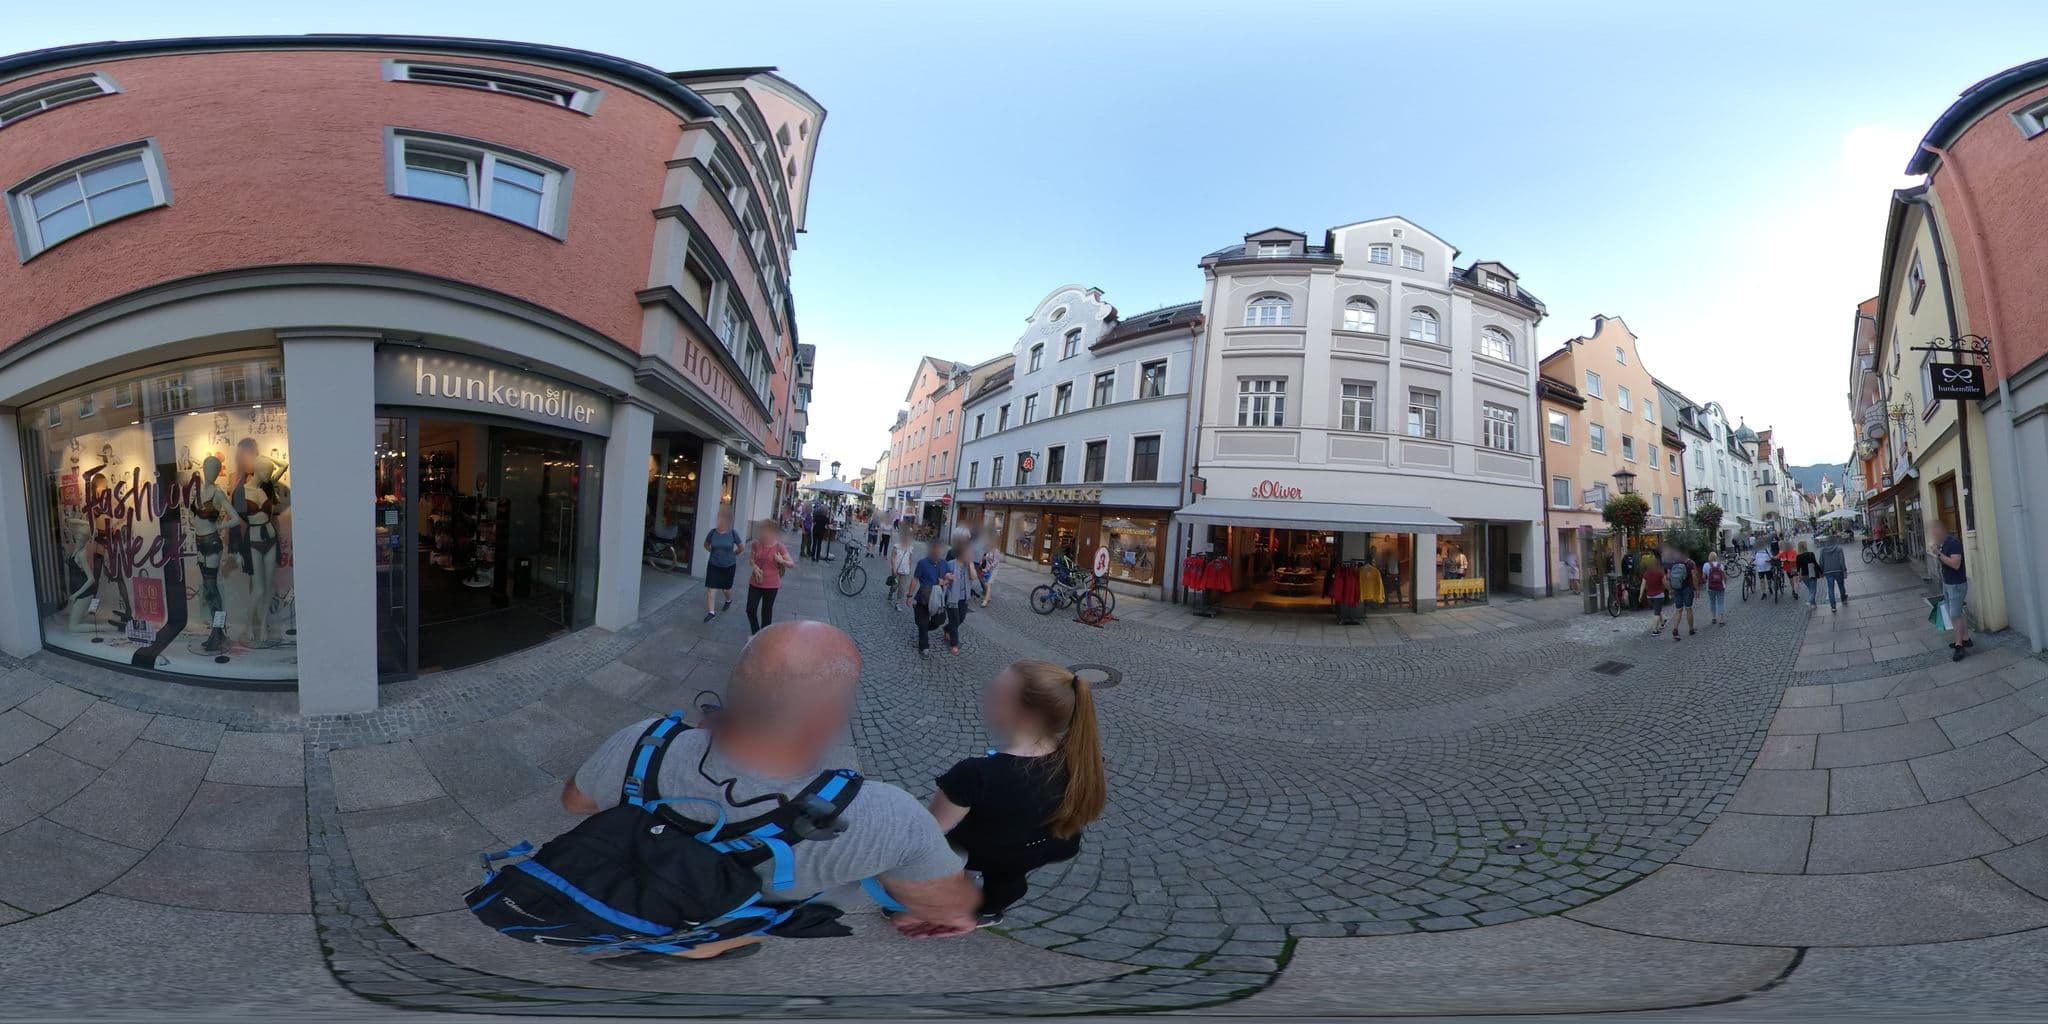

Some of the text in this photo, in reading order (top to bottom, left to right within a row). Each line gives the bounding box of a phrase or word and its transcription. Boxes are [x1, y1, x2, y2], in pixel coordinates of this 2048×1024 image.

[683, 336, 734, 409] HOTEL
[82, 464, 202, 536] Fashion
[1251, 479, 1303, 499] s.Oliver
[103, 506, 198, 582] Week
